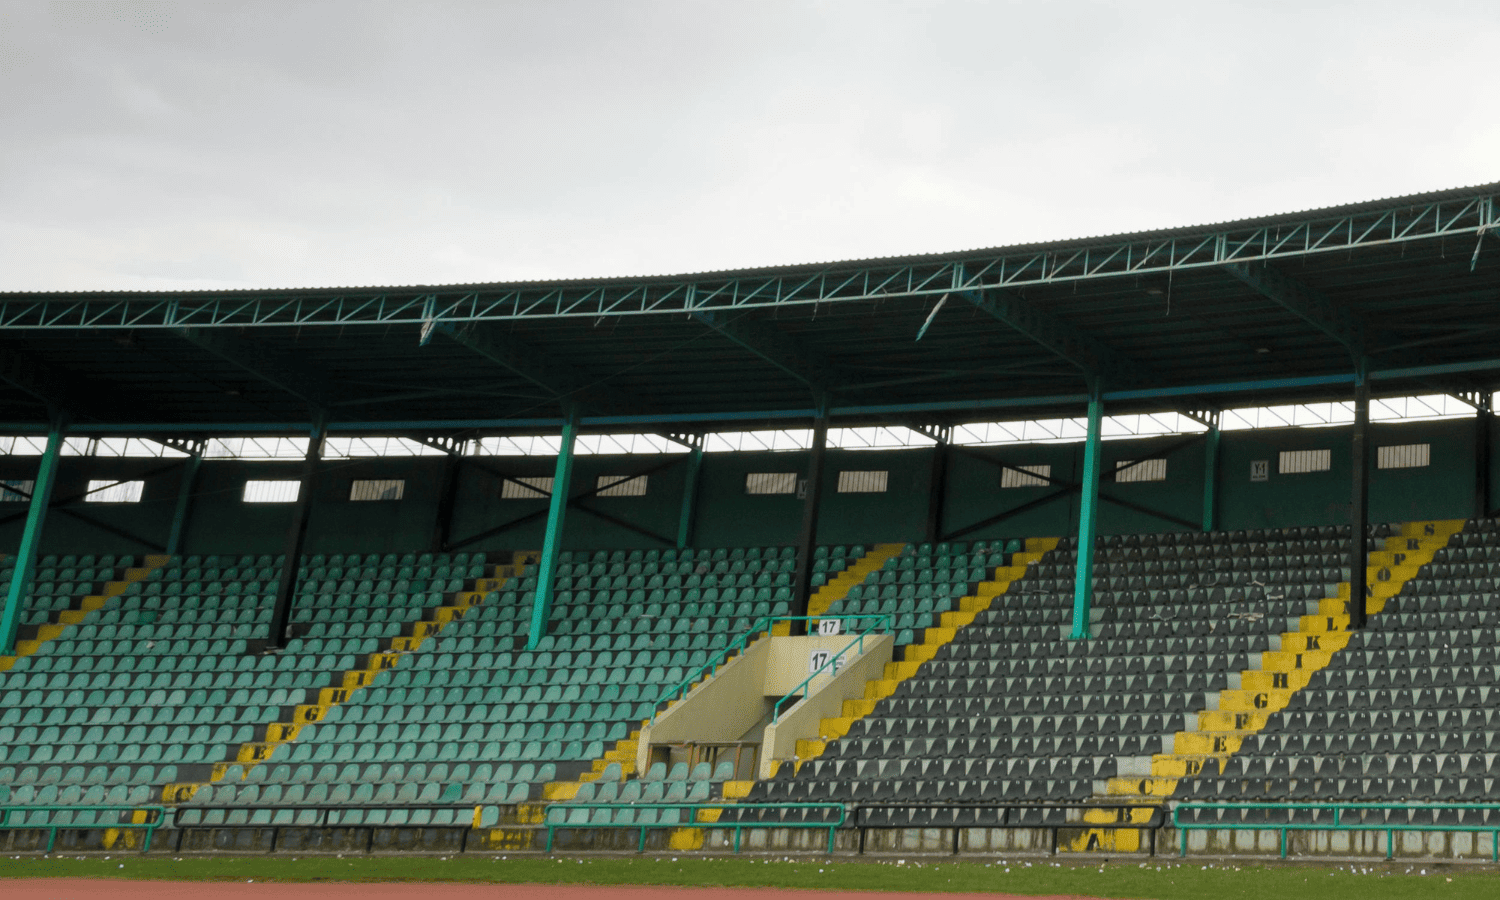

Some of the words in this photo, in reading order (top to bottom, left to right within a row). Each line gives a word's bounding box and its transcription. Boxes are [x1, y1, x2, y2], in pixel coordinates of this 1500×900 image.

[1423, 523, 1435, 536] S
[1406, 538, 1420, 550] R
[1394, 553, 1406, 566] P
[1377, 567, 1391, 582] O
[822, 621, 836, 634] 17
[1326, 617, 1339, 632] L
[1305, 635, 1321, 650] K
[380, 655, 397, 669] K
[812, 652, 828, 671] 17
[1295, 653, 1303, 669] I
[357, 672, 367, 686] I
[1272, 672, 1289, 689] H
[331, 689, 347, 703] H
[1254, 693, 1268, 709] G
[304, 707, 319, 721] G
[1235, 713, 1249, 730] F
[280, 725, 295, 740] F
[1213, 735, 1227, 753] E
[252, 746, 267, 760] E
[1138, 778, 1154, 796] C
[174, 787, 191, 803] C
[1086, 832, 1102, 851] A
